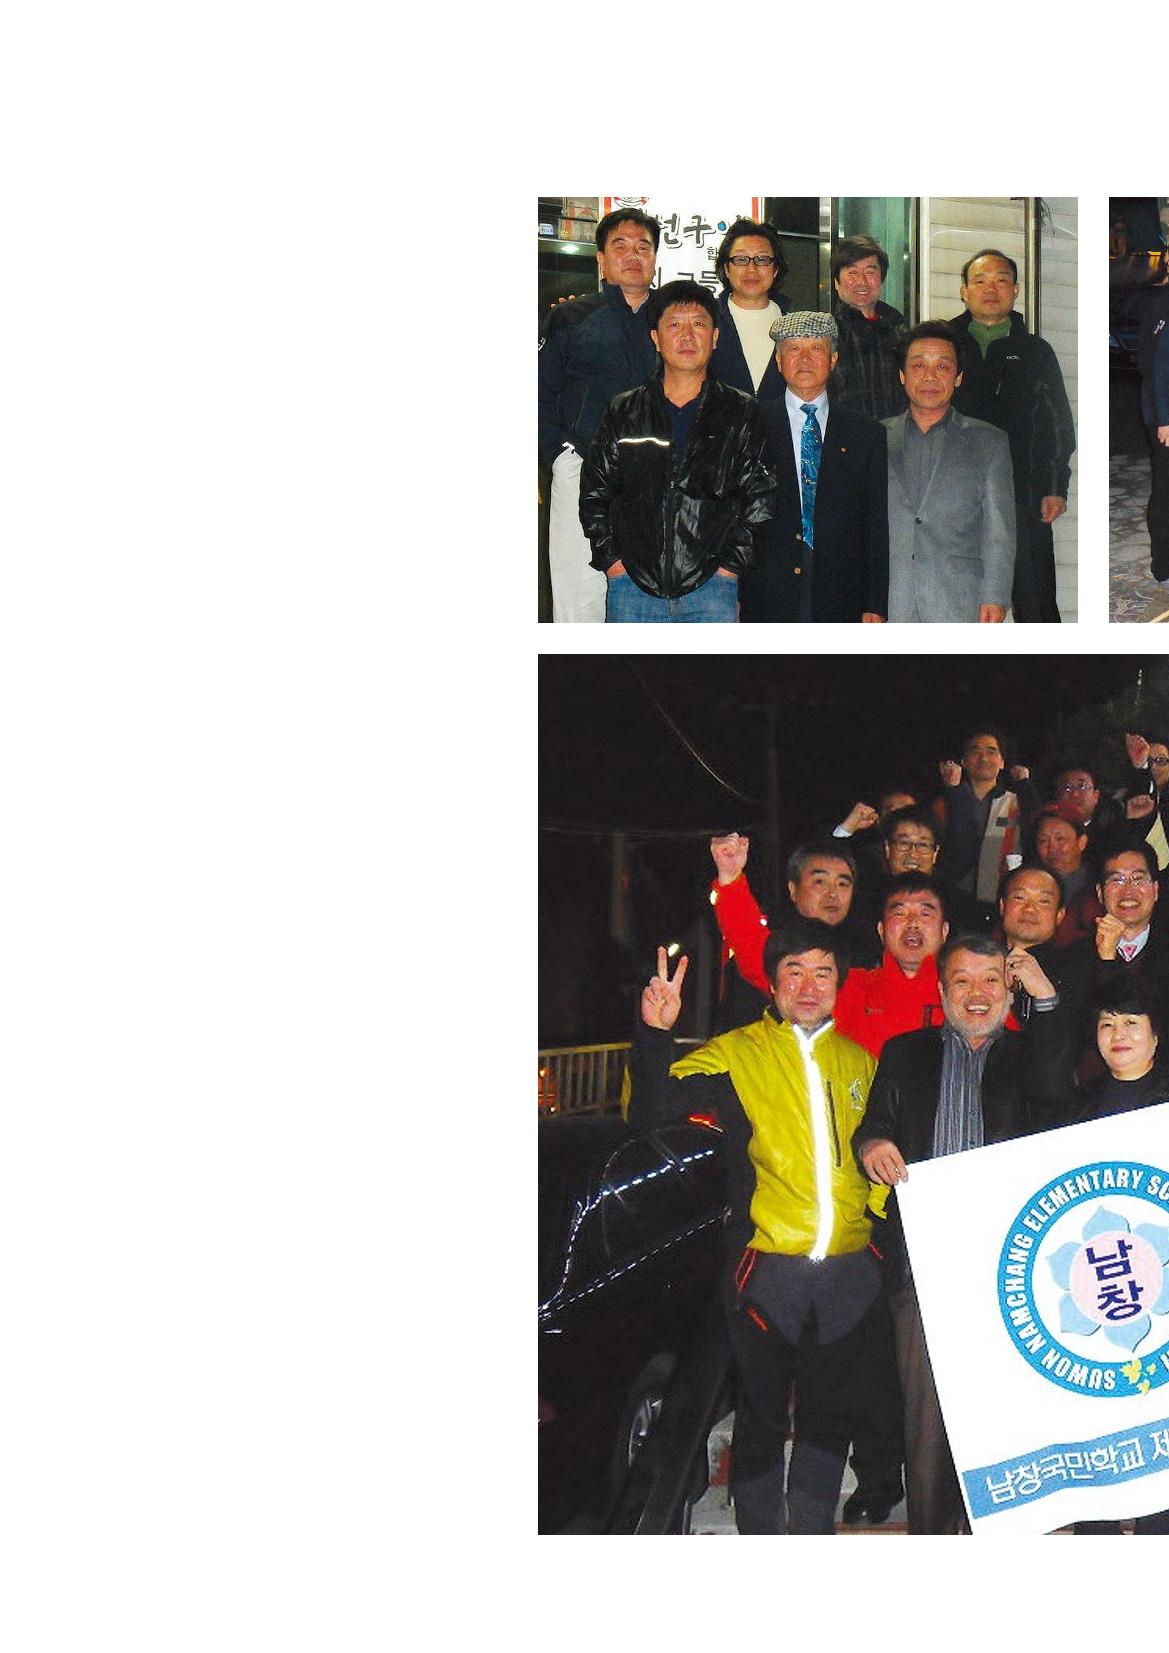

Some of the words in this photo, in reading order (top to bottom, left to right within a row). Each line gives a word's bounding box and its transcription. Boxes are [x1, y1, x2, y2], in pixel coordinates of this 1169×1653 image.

[1022, 1168, 1144, 1233] ELEMENTARY
[1005, 1232, 1047, 1356] NAMCHANG
[1085, 1239, 1144, 1321] 남창
[1041, 1348, 1116, 1391] SUWON
[985, 1441, 1146, 1505] 남창국민학교
